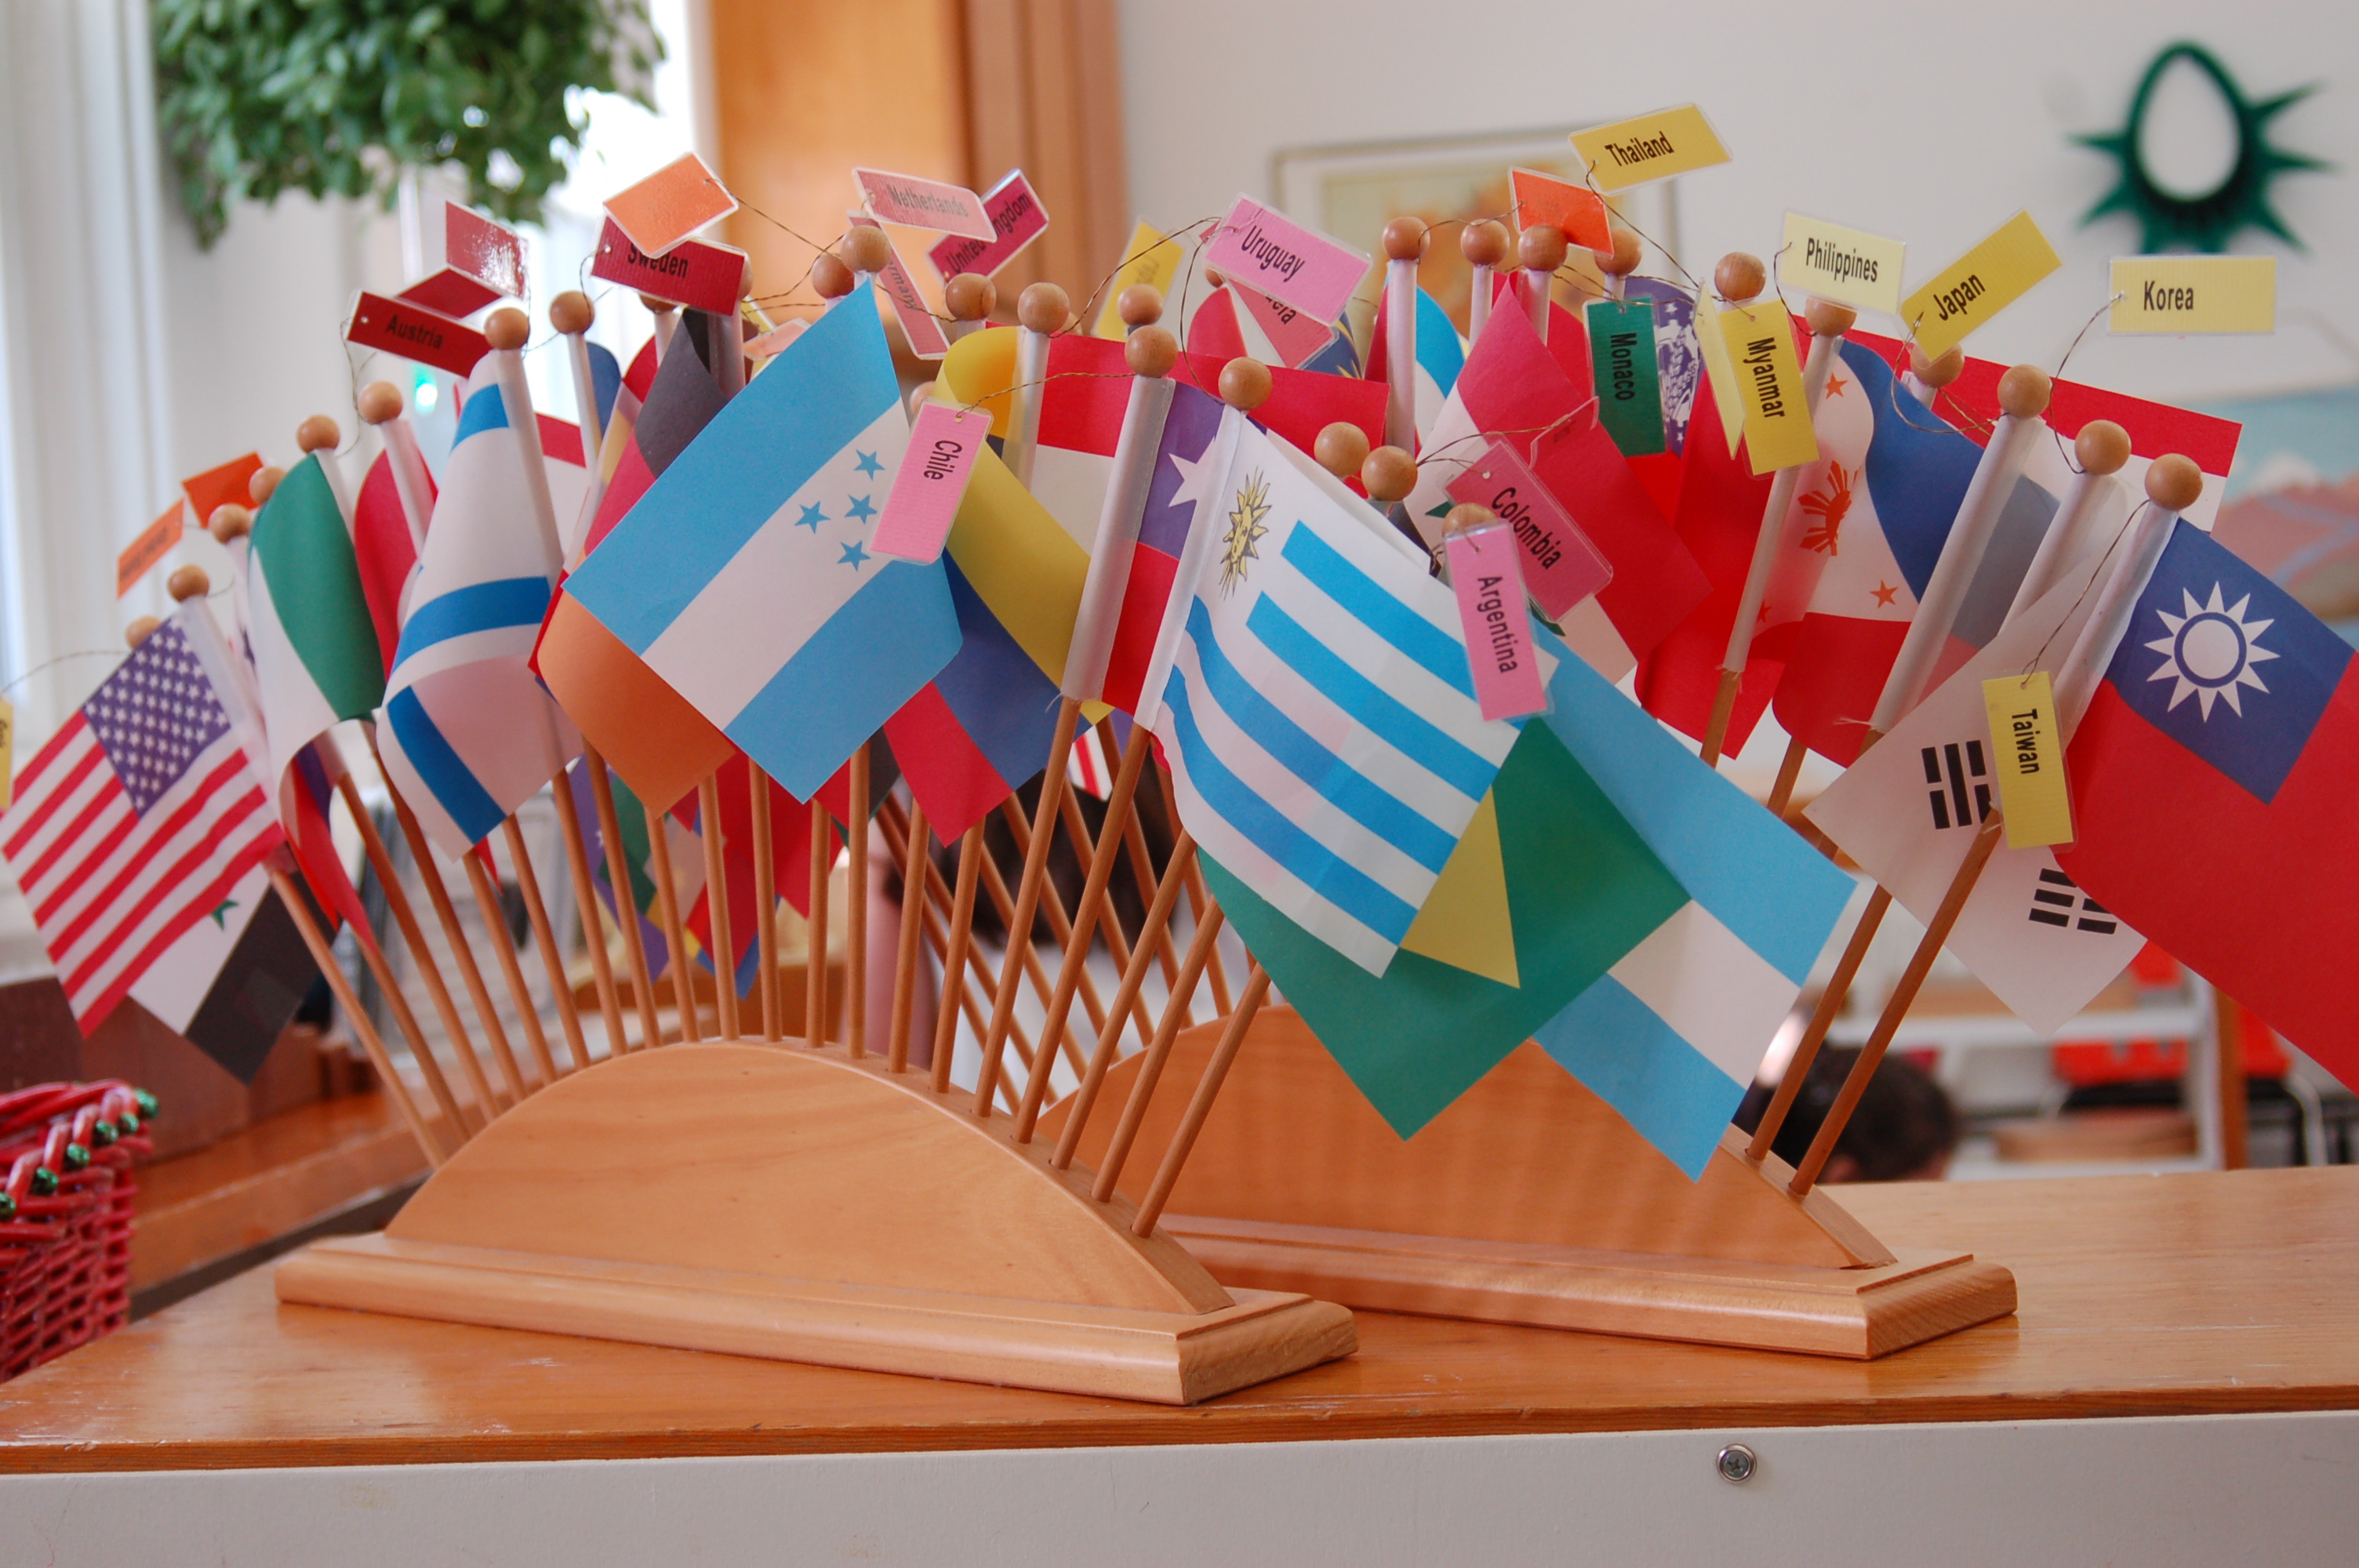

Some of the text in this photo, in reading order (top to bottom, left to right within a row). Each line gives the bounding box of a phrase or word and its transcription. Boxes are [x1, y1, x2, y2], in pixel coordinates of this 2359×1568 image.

[1604, 130, 1674, 167] Thailand
[886, 184, 969, 218] Netherlands
[993, 193, 1033, 236] ngdom
[1241, 225, 1305, 282] Uruguay
[1806, 238, 1879, 283] Philippines
[889, 260, 919, 312] rmany
[1933, 273, 1986, 321] Japan
[2143, 281, 2194, 310] Korea
[385, 314, 444, 350] Austria
[1610, 332, 1637, 401] Monaco
[1743, 337, 1786, 418] Myanmar
[923, 440, 963, 480] Chile
[1491, 486, 1561, 570] Colombia
[1477, 576, 1518, 673] Argentina
[2012, 708, 2041, 775] Taiwan
